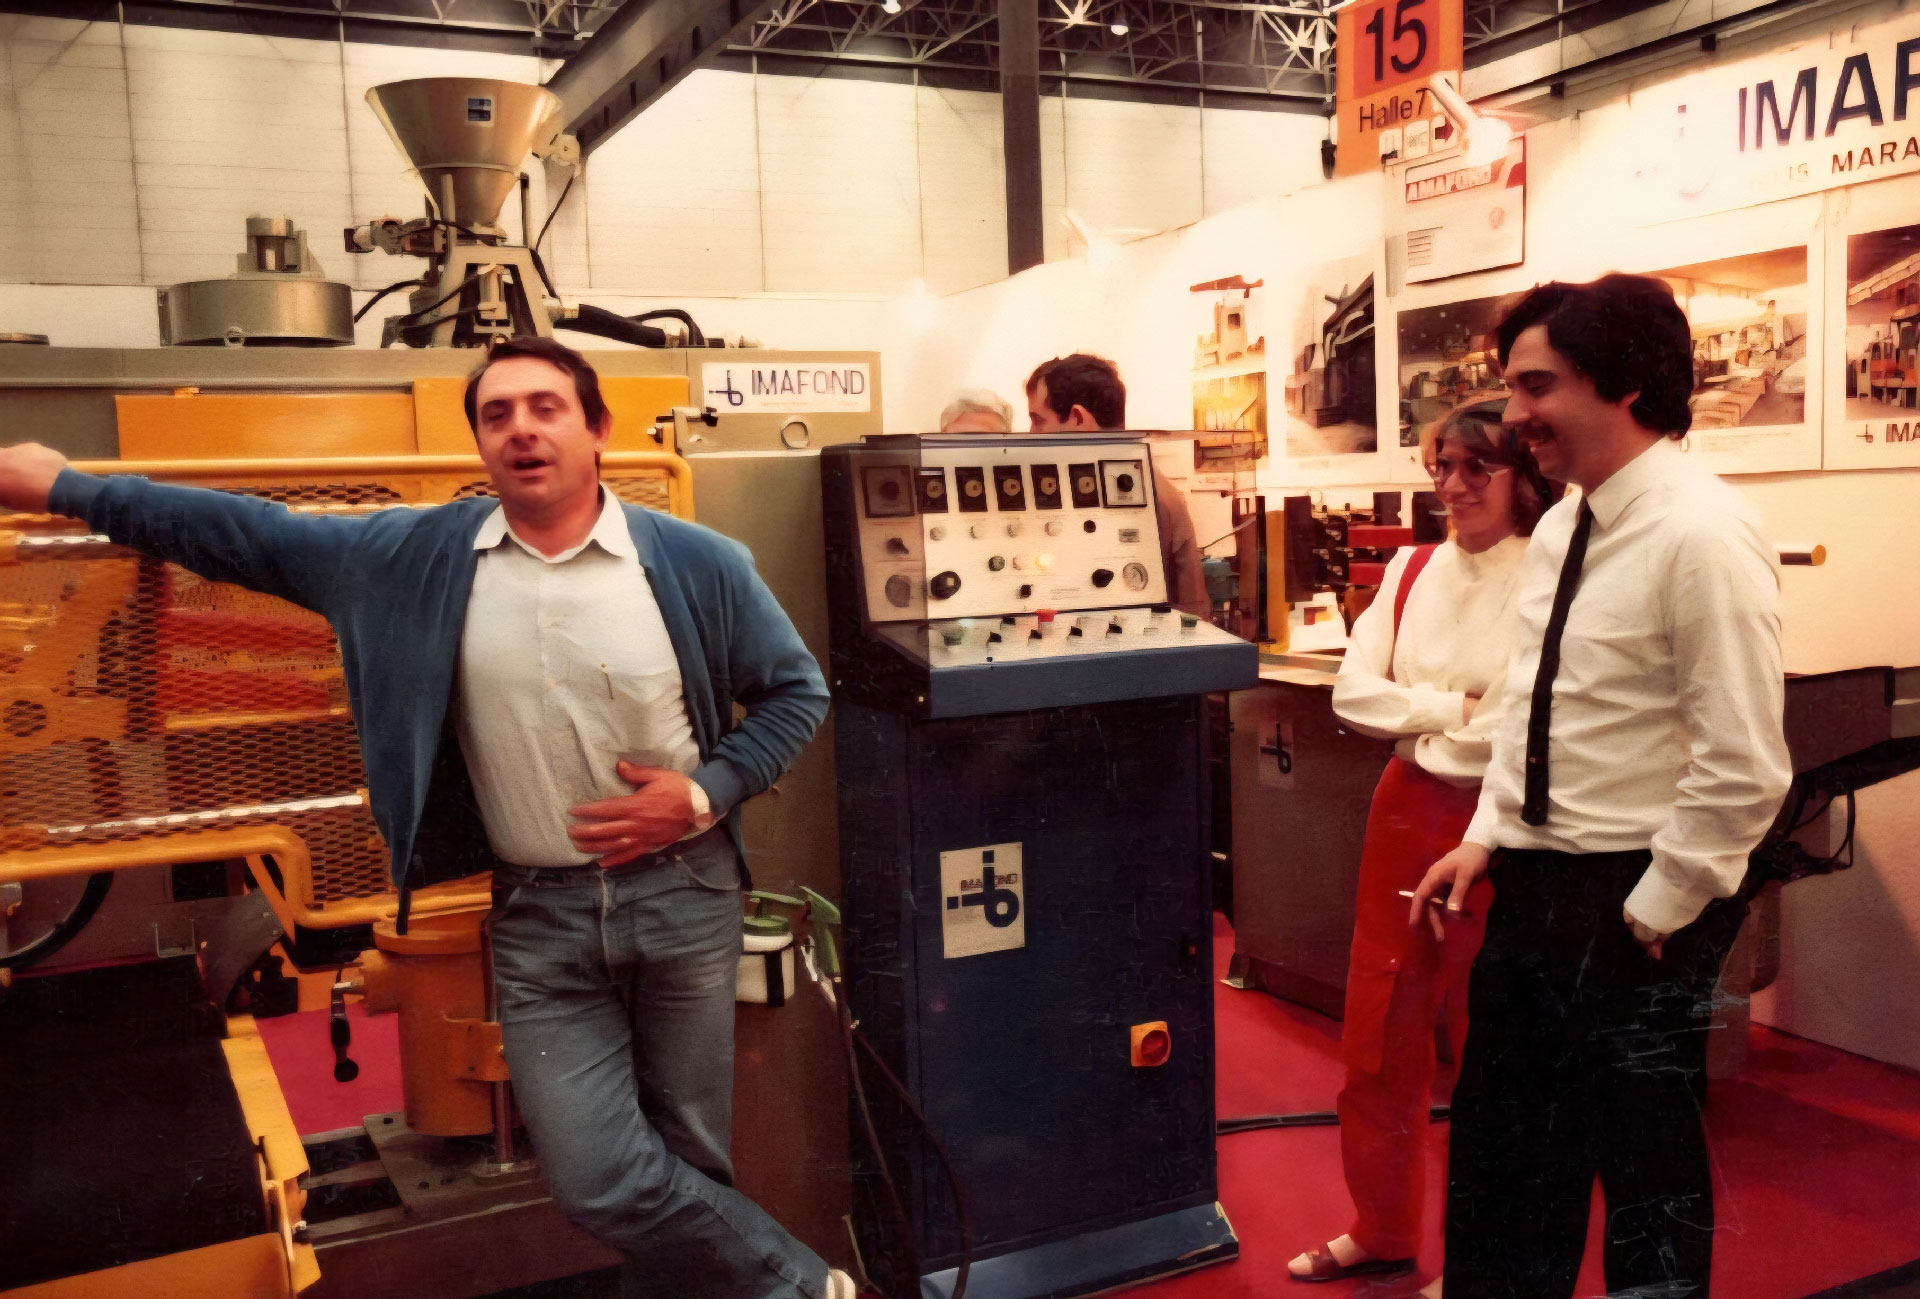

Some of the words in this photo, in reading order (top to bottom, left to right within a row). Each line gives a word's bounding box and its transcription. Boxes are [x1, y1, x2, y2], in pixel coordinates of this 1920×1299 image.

[1365, 0, 1427, 81] 15
[1359, 95, 1412, 132] Halle
[1416, 87, 1429, 115] 7
[1831, 136, 1920, 174] MARA
[751, 369, 865, 395] IMAFOND
